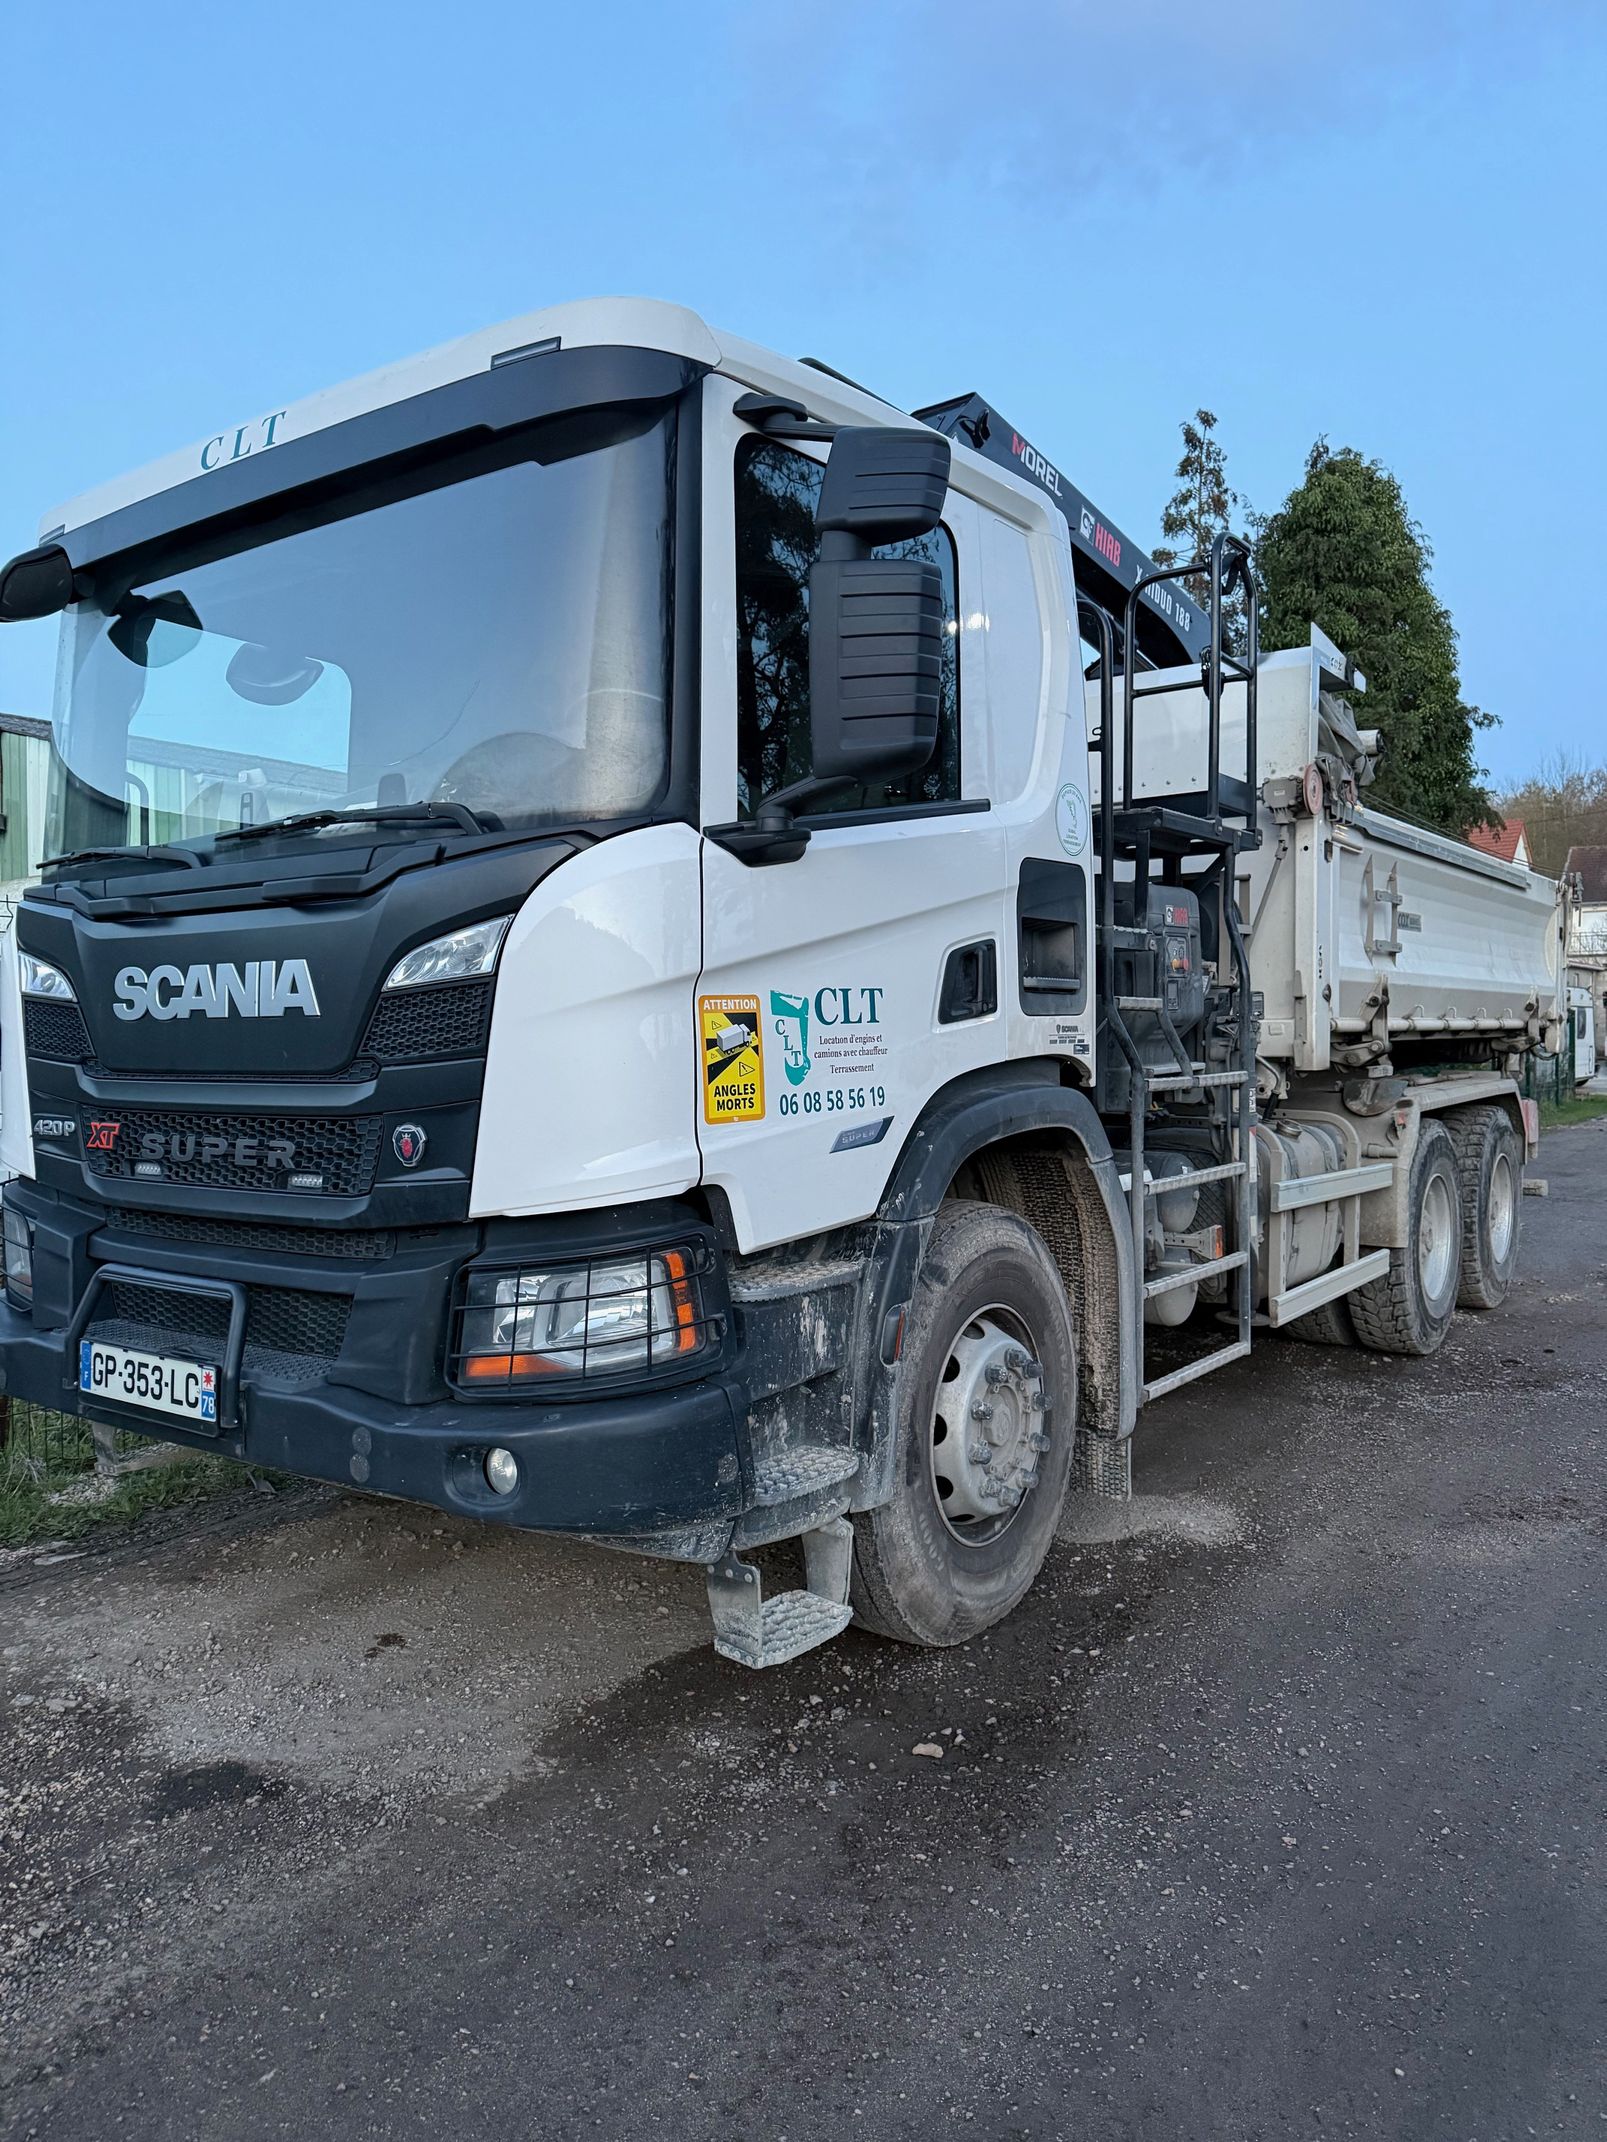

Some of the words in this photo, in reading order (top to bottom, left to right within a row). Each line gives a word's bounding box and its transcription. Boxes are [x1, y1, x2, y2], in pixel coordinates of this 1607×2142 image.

[201, 410, 287, 470] CLT
[1012, 432, 1063, 498] MOREL
[1095, 522, 1121, 567] HIAB
[1175, 602, 1191, 632] 188
[112, 959, 321, 1021] SCANIA
[703, 999, 757, 1011] ATTENTION
[814, 987, 884, 1026] CLT
[814, 1048, 842, 1059] camions
[858, 1046, 888, 1057] chauffeur
[819, 1035, 848, 1045] Location
[849, 1033, 876, 1046] d'engins
[876, 1034, 883, 1043] et
[830, 1063, 875, 1074] Terrassement
[714, 1083, 756, 1097] ANGLES
[716, 1097, 755, 1112] MORTS
[780, 1093, 799, 1116] 06
[803, 1091, 821, 1114] 08
[826, 1089, 844, 1112] 58
[848, 1087, 865, 1109] 56
[869, 1086, 885, 1107] 19
[86, 1122, 121, 1150] XT
[141, 1133, 296, 1169] SUPER
[84, 1371, 89, 1381] F
[92, 1352, 200, 1409] GP-353-LC
[202, 1395, 215, 1415] 78
